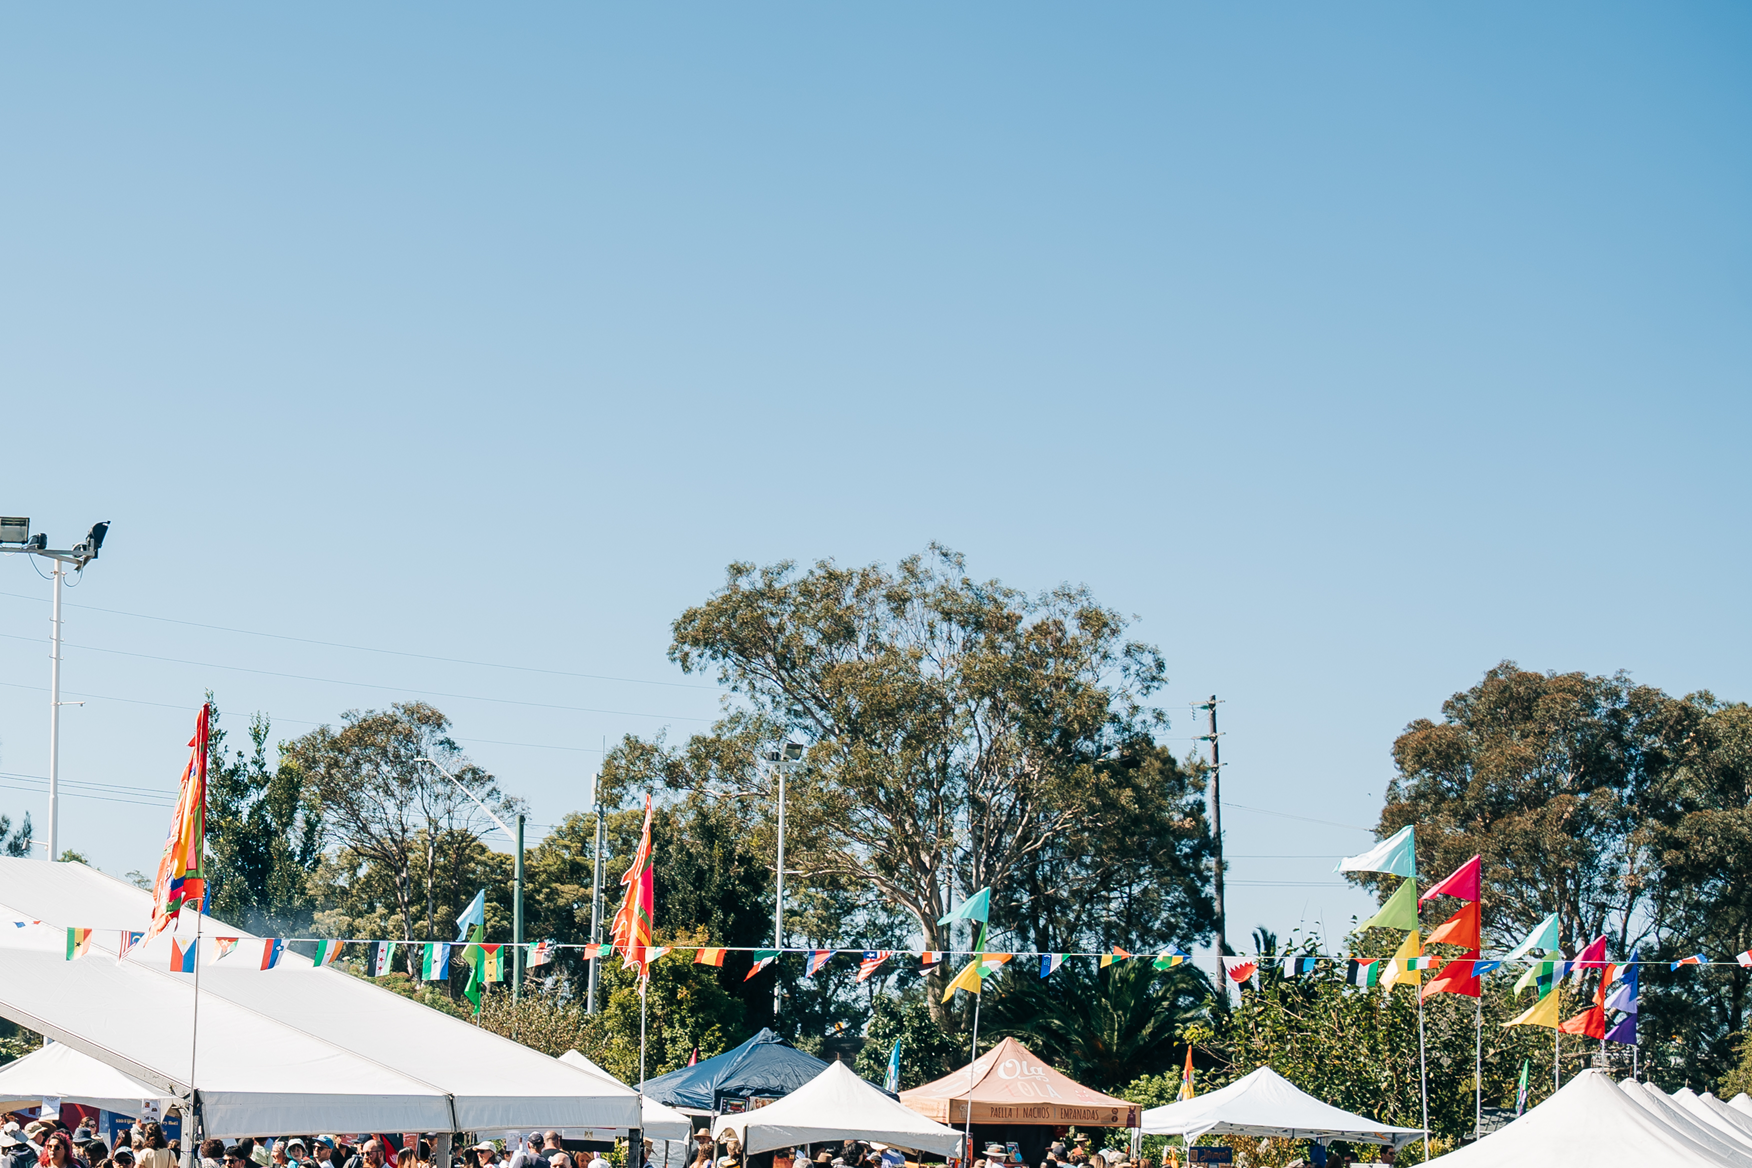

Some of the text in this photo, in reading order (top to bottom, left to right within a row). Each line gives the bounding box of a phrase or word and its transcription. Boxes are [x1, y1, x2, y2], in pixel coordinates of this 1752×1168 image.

[997, 1058, 1046, 1080] Ola
[1005, 1081, 1063, 1099] LOLA
[990, 1106, 1100, 1121] PAELLA NACHOS EMPANADAS
